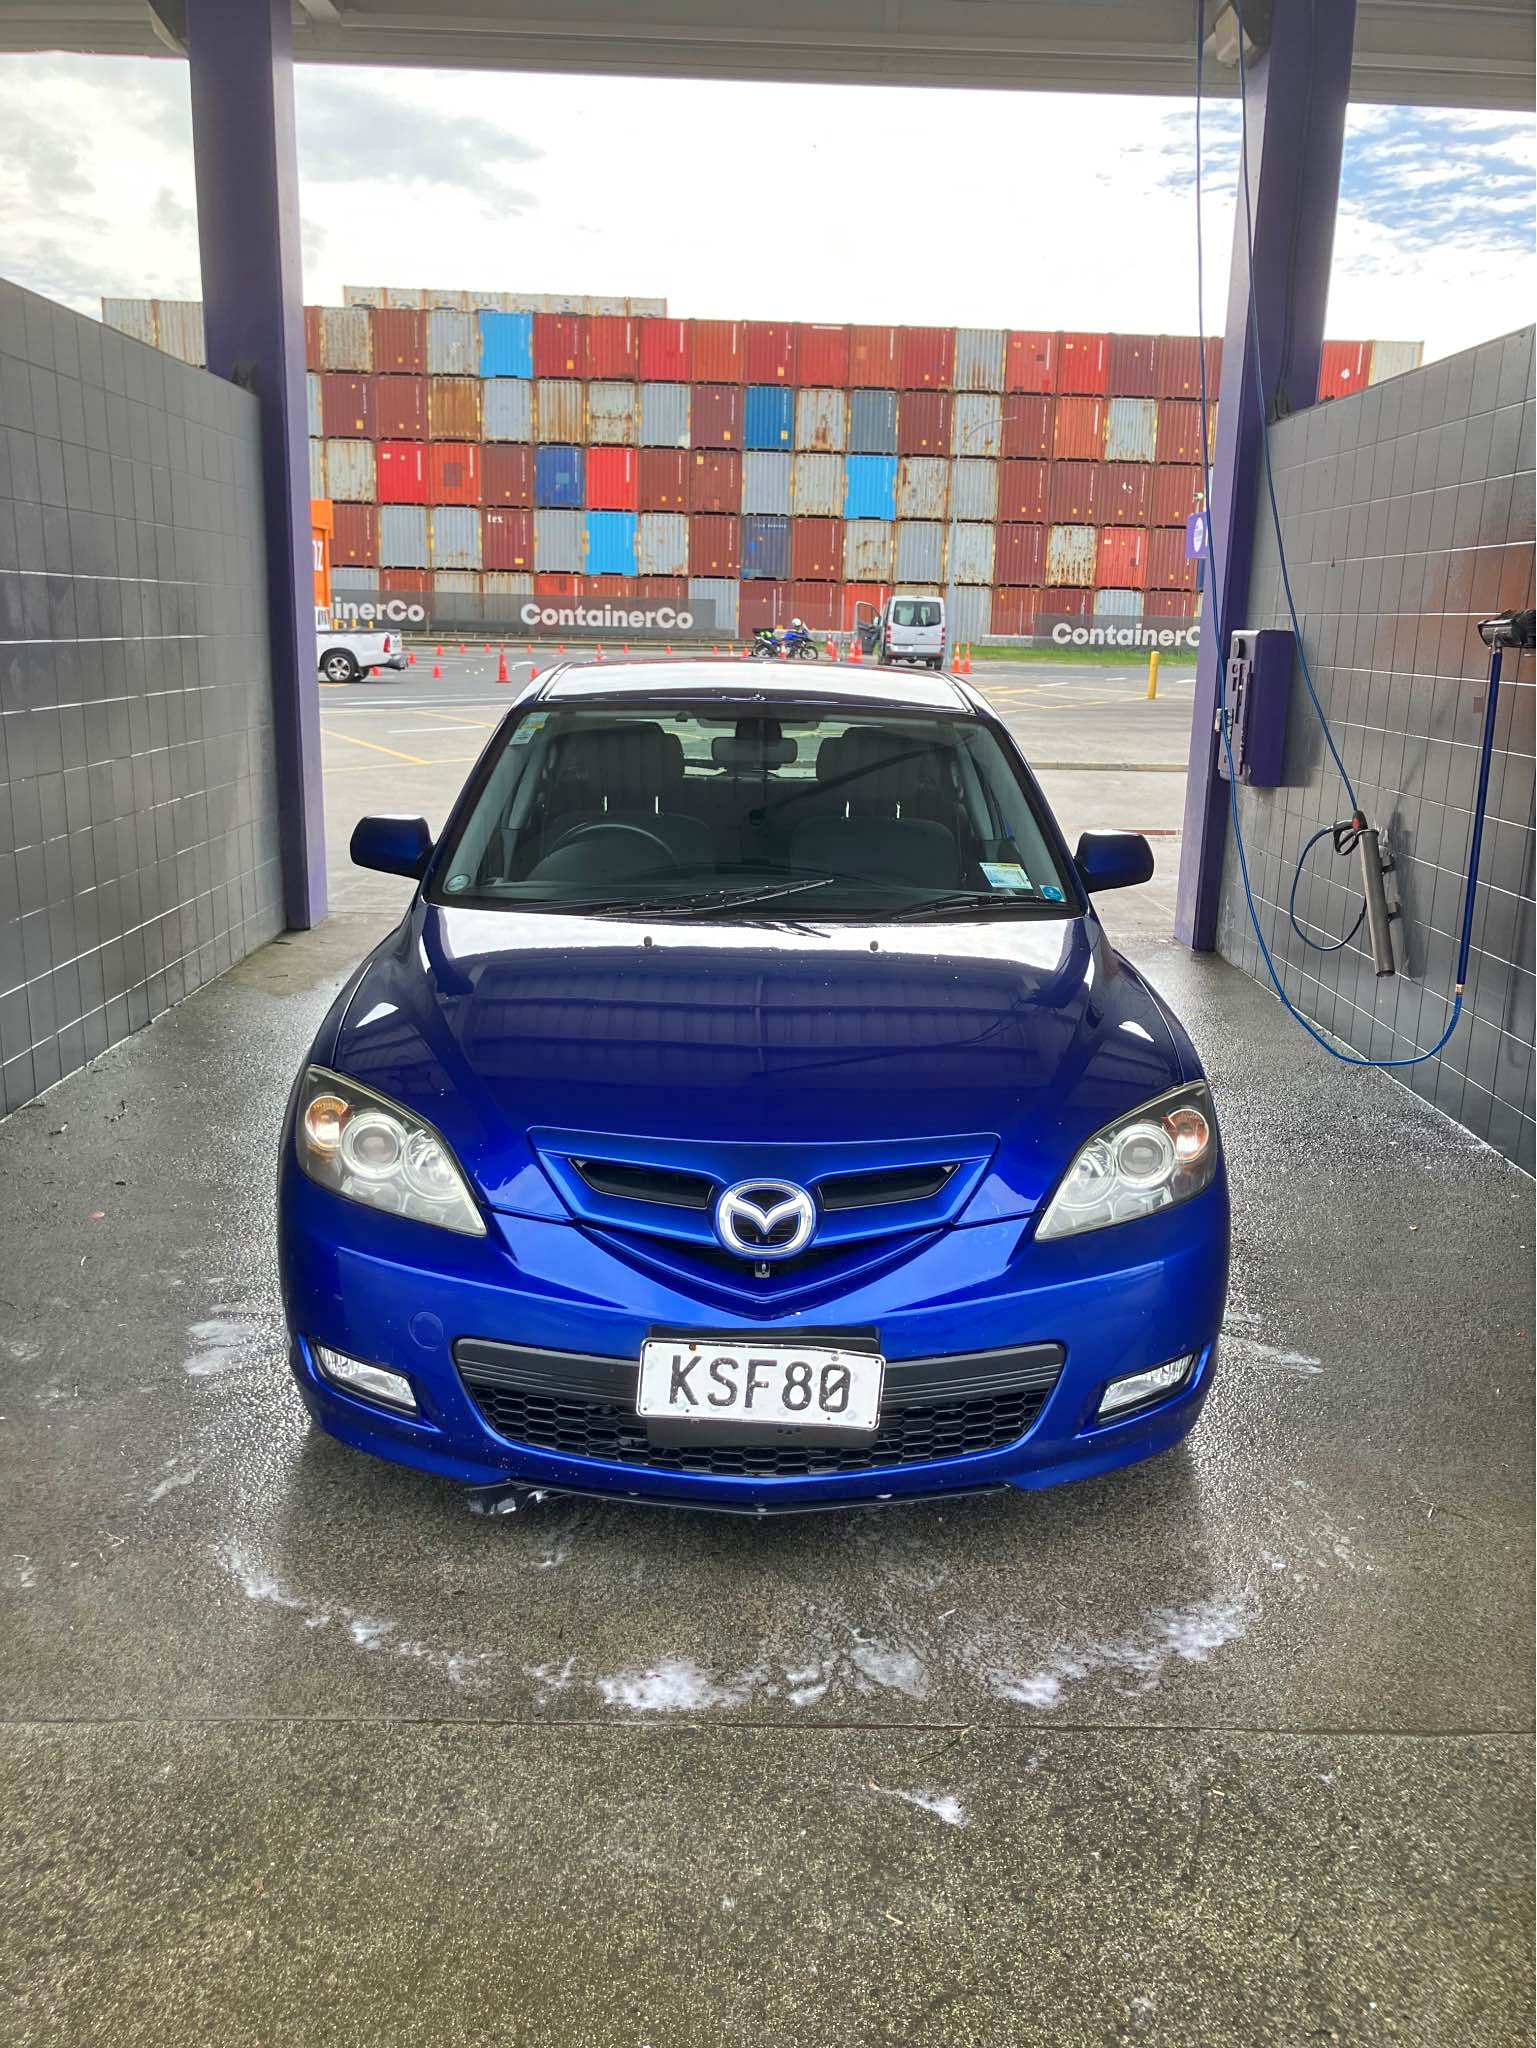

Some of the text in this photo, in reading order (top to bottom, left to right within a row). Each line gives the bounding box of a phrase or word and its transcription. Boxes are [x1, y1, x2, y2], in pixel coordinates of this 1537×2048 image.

[331, 596, 425, 622] inerCo
[520, 603, 694, 629] ContainerCo
[1052, 622, 1200, 647] ContainerC
[668, 1354, 852, 1413] KSF80
